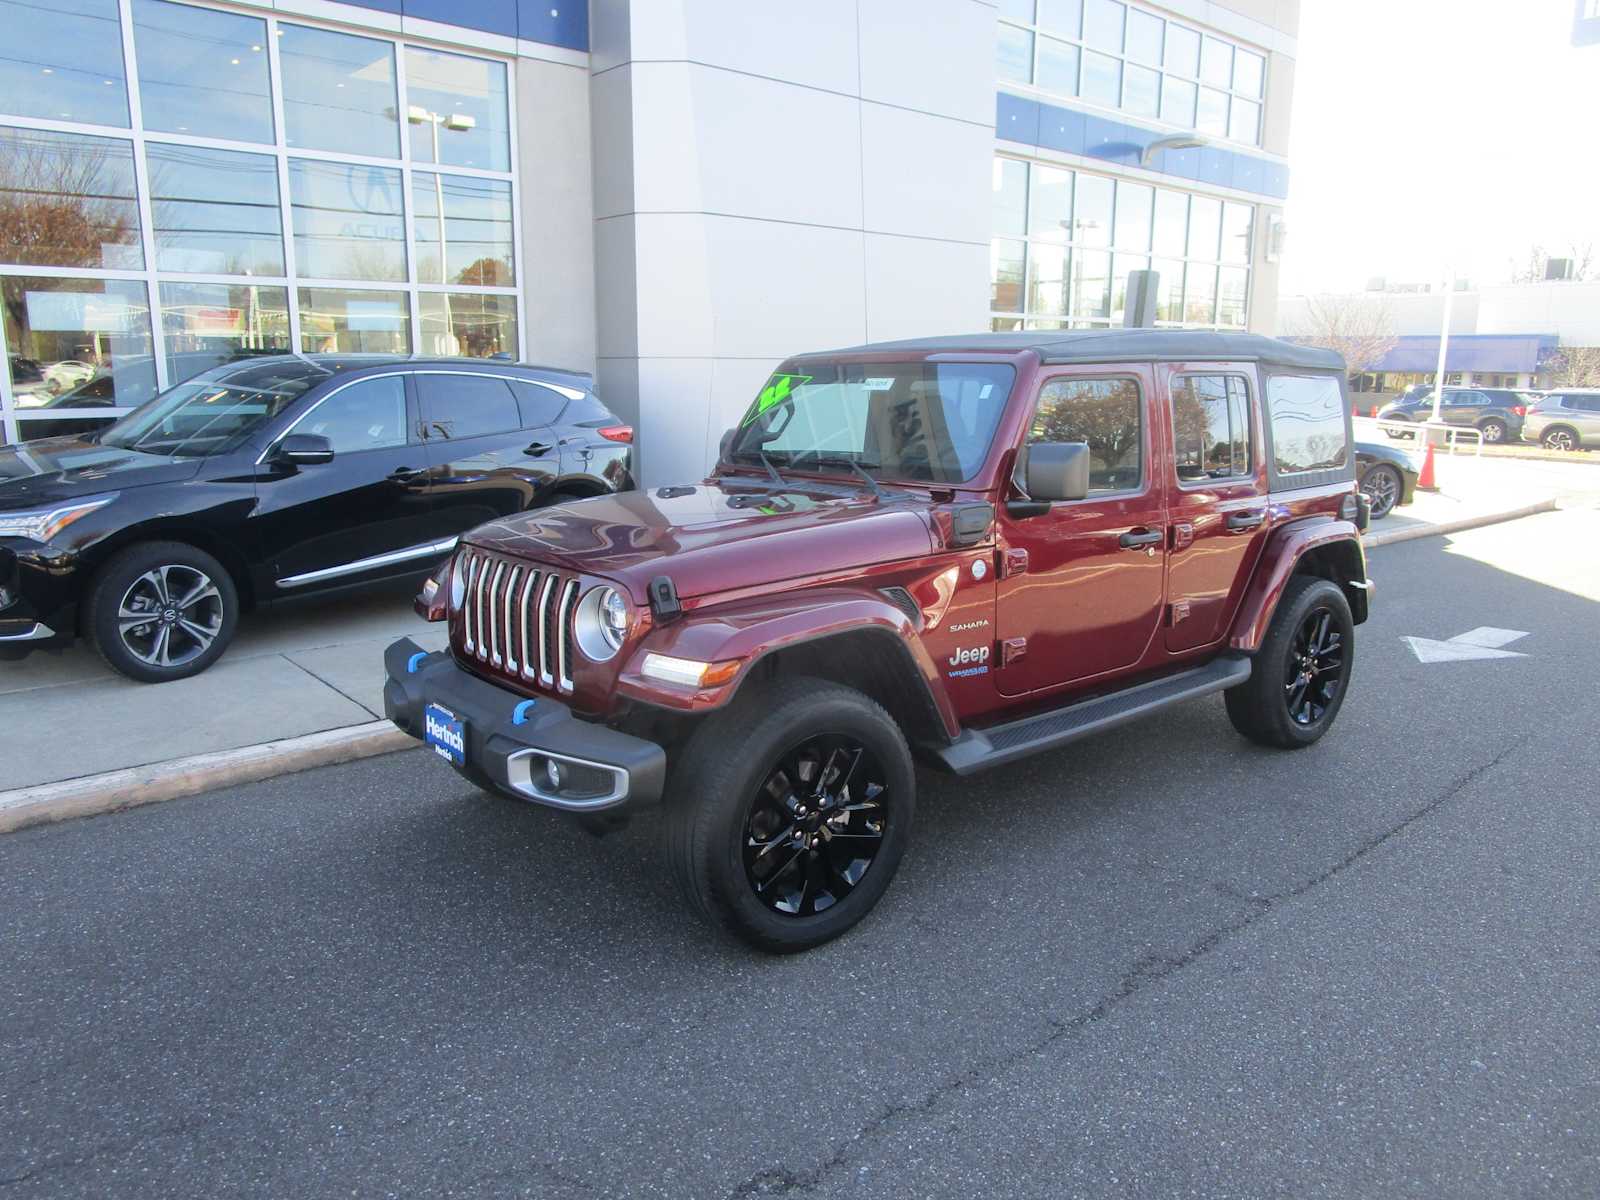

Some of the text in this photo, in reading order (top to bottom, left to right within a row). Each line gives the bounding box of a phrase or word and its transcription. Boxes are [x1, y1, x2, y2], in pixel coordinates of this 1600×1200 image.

[949, 619, 989, 632] SAHARA
[949, 646, 989, 666] Jeep
[426, 714, 464, 753] Hertrich
